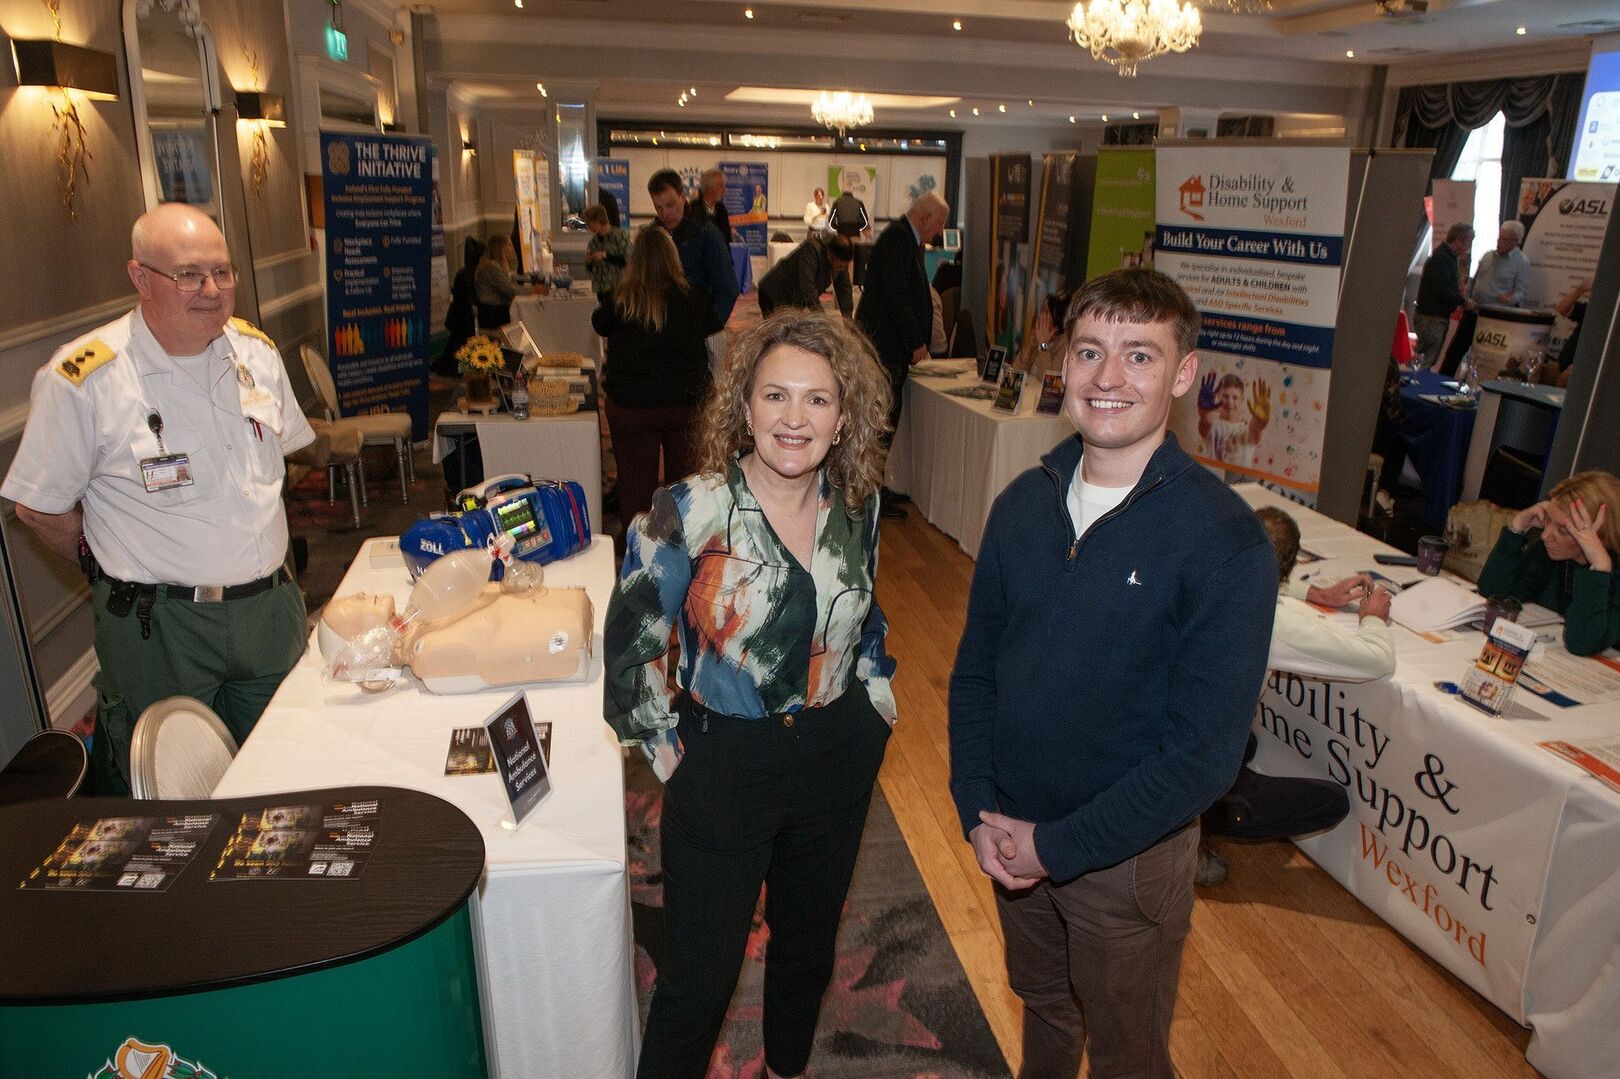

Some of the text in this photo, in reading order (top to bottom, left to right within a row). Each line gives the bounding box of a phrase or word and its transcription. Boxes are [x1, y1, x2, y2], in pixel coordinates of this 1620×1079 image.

[355, 142, 426, 163] THE THRIVE
[358, 160, 422, 179] INITIATIVE
[1209, 174, 1295, 196] Disability &
[1208, 191, 1308, 215] Home Support
[1573, 199, 1608, 216] ASL
[1264, 213, 1308, 229] Wexford
[1162, 230, 1329, 259] Build Your Career With Us
[1210, 275, 1242, 288] ADULTS
[1243, 279, 1249, 288] &
[1250, 280, 1291, 292] CHILDREN
[1225, 289, 1267, 302] Intellectual
[1268, 293, 1310, 307] Disabilities
[1225, 301, 1252, 312] Specific
[1253, 303, 1284, 315] Services
[1203, 318, 1286, 336] services range from
[1484, 331, 1508, 348] ASL
[420, 538, 446, 556] ZOLL
[1266, 672, 1460, 815] ability &
[507, 741, 530, 768] National
[507, 753, 536, 784] Ambulance
[515, 769, 537, 792] Services
[1258, 702, 1498, 912] me Support
[1359, 820, 1487, 969] Wexford
